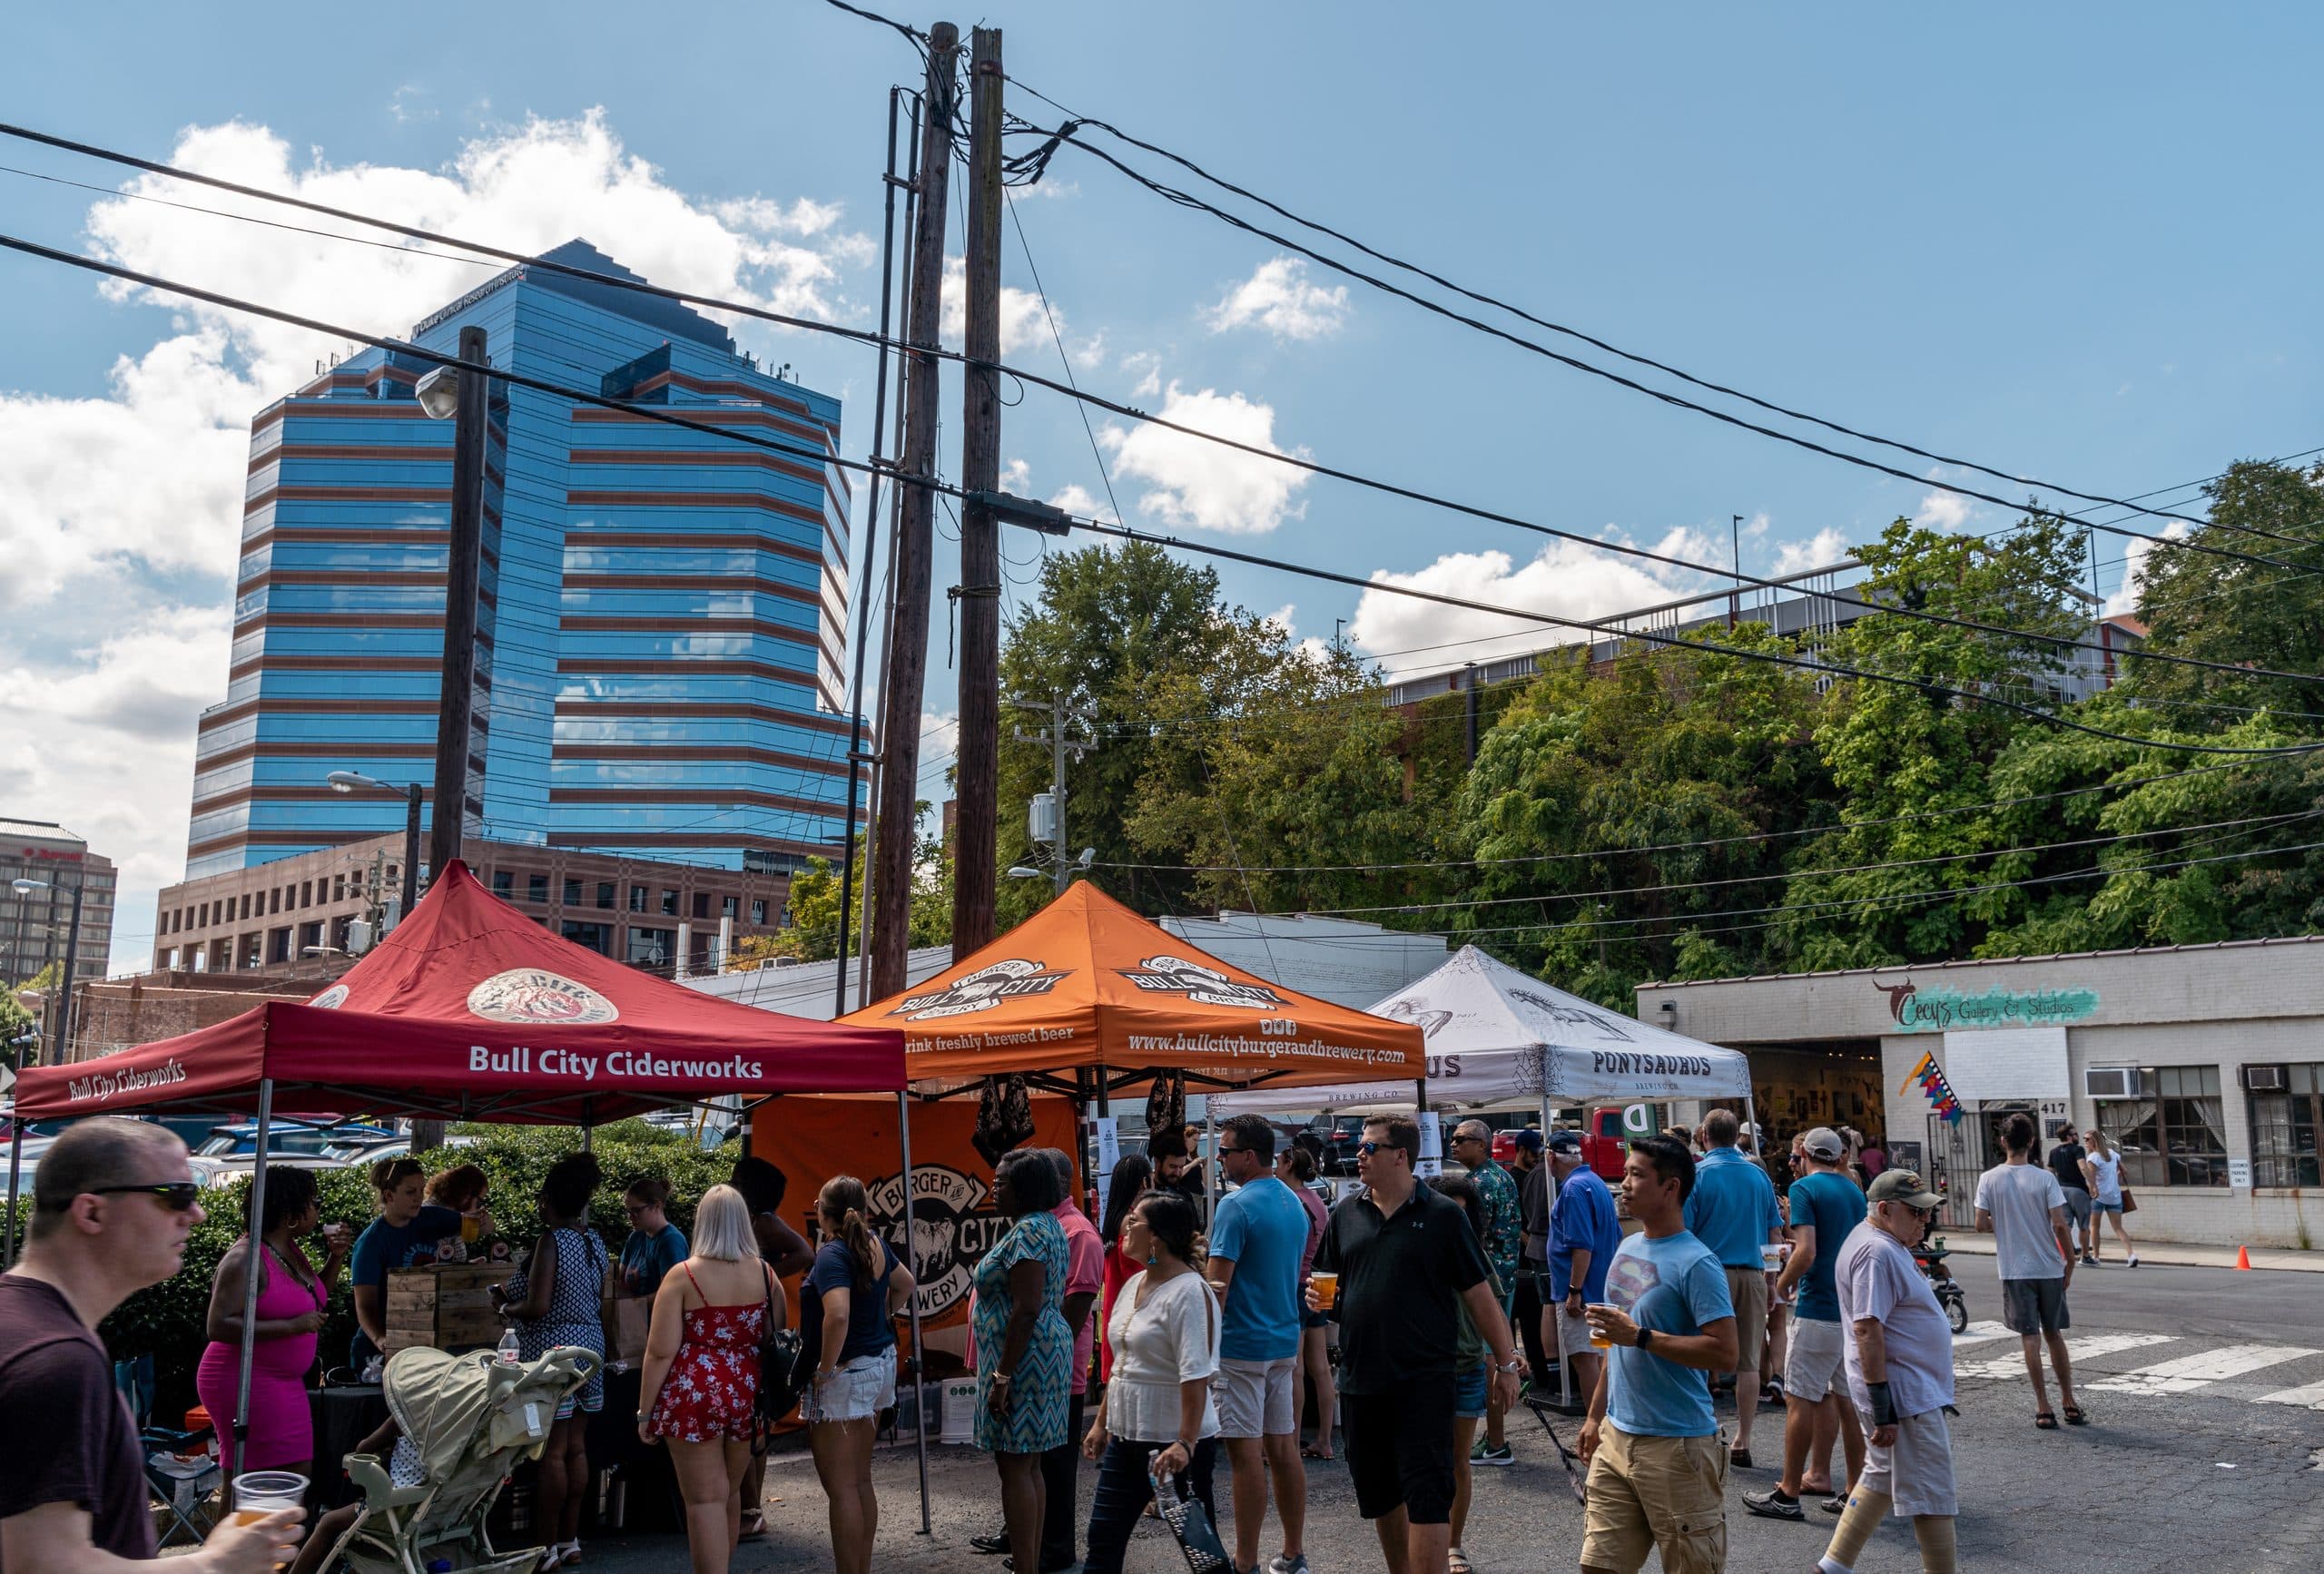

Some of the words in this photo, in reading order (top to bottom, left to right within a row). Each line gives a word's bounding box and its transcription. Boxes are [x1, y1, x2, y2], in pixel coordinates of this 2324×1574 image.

[420, 315, 439, 333] Duke
[440, 299, 463, 320] Clinical
[464, 283, 495, 308] Research
[892, 989, 954, 1014] BULL
[999, 976, 1064, 995] CITY
[1127, 974, 1196, 989] BULL
[1227, 984, 1282, 1002] CITY
[1958, 1000, 1998, 1022] Gallery
[2004, 1000, 2020, 1017] &
[2027, 997, 2074, 1015] Studios
[904, 1039, 933, 1054] rink
[935, 1033, 981, 1052] freshly
[985, 1028, 1037, 1048] brewed
[1039, 1026, 1075, 1041] beer
[1128, 1032, 1406, 1065] www.bullcityburgerandbrewery.com
[468, 1046, 530, 1072] Bull
[538, 1049, 598, 1081] City
[606, 1051, 763, 1079] Ciderworks
[1591, 1051, 1711, 1076] PONYSAURUS
[69, 1077, 91, 1101] Bull
[93, 1074, 115, 1101] City
[116, 1058, 187, 1093] Ciderworks
[1328, 1092, 1378, 1102] BREWING
[2041, 1103, 2065, 1113] 417
[907, 1272, 960, 1311] WERY
